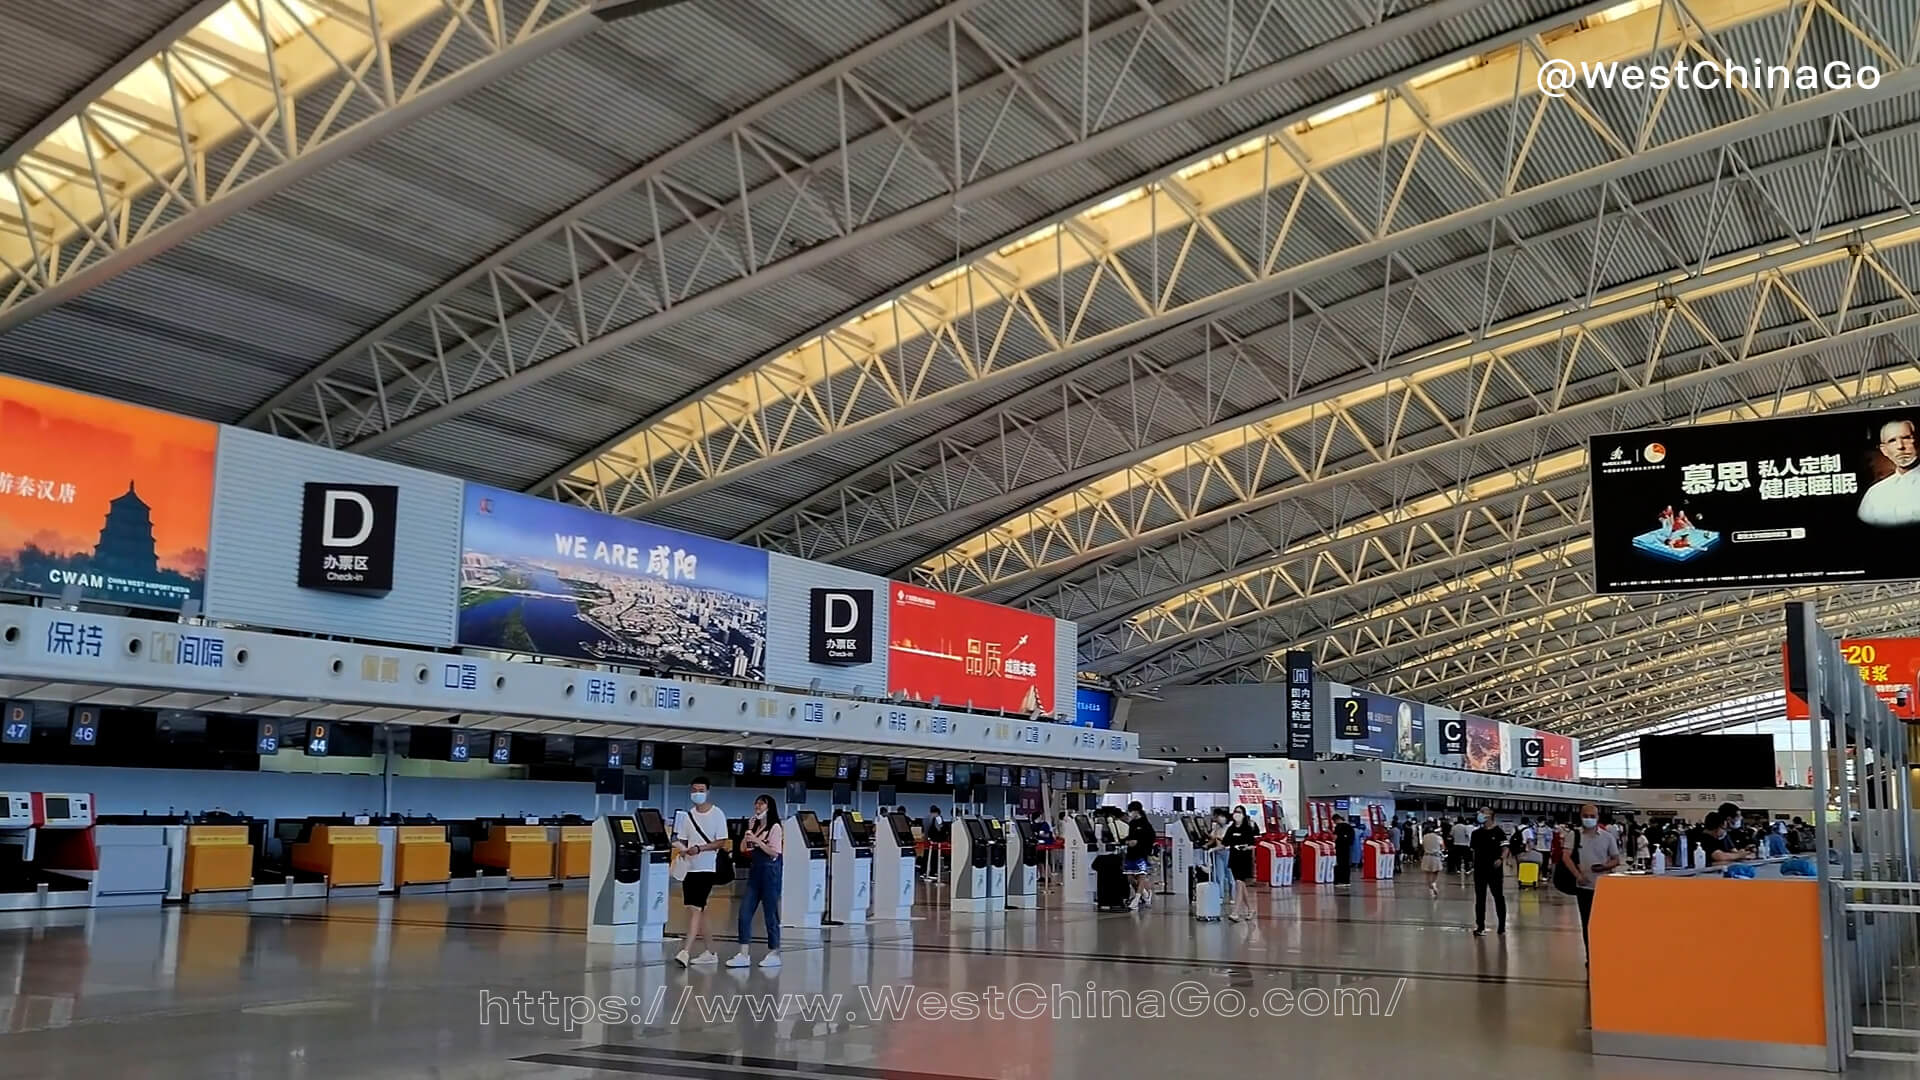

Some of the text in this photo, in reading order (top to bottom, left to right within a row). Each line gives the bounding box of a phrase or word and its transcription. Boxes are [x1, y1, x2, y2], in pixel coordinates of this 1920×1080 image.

[1758, 454, 1842, 478] 私人定制
[1681, 461, 1751, 495] 慕思
[1758, 473, 1858, 500] 健康睡眠
[322, 489, 374, 548] D
[323, 554, 369, 571] 办票区
[555, 533, 698, 580] WE ARE 咸阳
[49, 569, 104, 589] CWAM
[326, 571, 364, 582] Check-in
[825, 593, 859, 633] D
[47, 621, 103, 658] 保持
[176, 634, 225, 668] 间隔
[965, 637, 1003, 678] 品质
[445, 663, 477, 690] 口罩
[586, 679, 681, 710] 保持 间隔
[1291, 688, 1311, 699] 国内
[1291, 700, 1311, 710] 安全
[13, 708, 25, 721] D
[81, 711, 92, 724] D
[6, 724, 28, 738] 47
[74, 727, 94, 741] 46
[264, 724, 272, 735] D
[315, 725, 324, 738] D
[1444, 721, 1462, 741] C
[259, 738, 276, 751] 45
[310, 739, 326, 752] 44
[457, 734, 465, 745] D
[498, 737, 506, 747] D
[453, 747, 466, 758] 43
[494, 750, 508, 761] 42
[1525, 740, 1540, 757] C
[608, 756, 620, 766] 41
